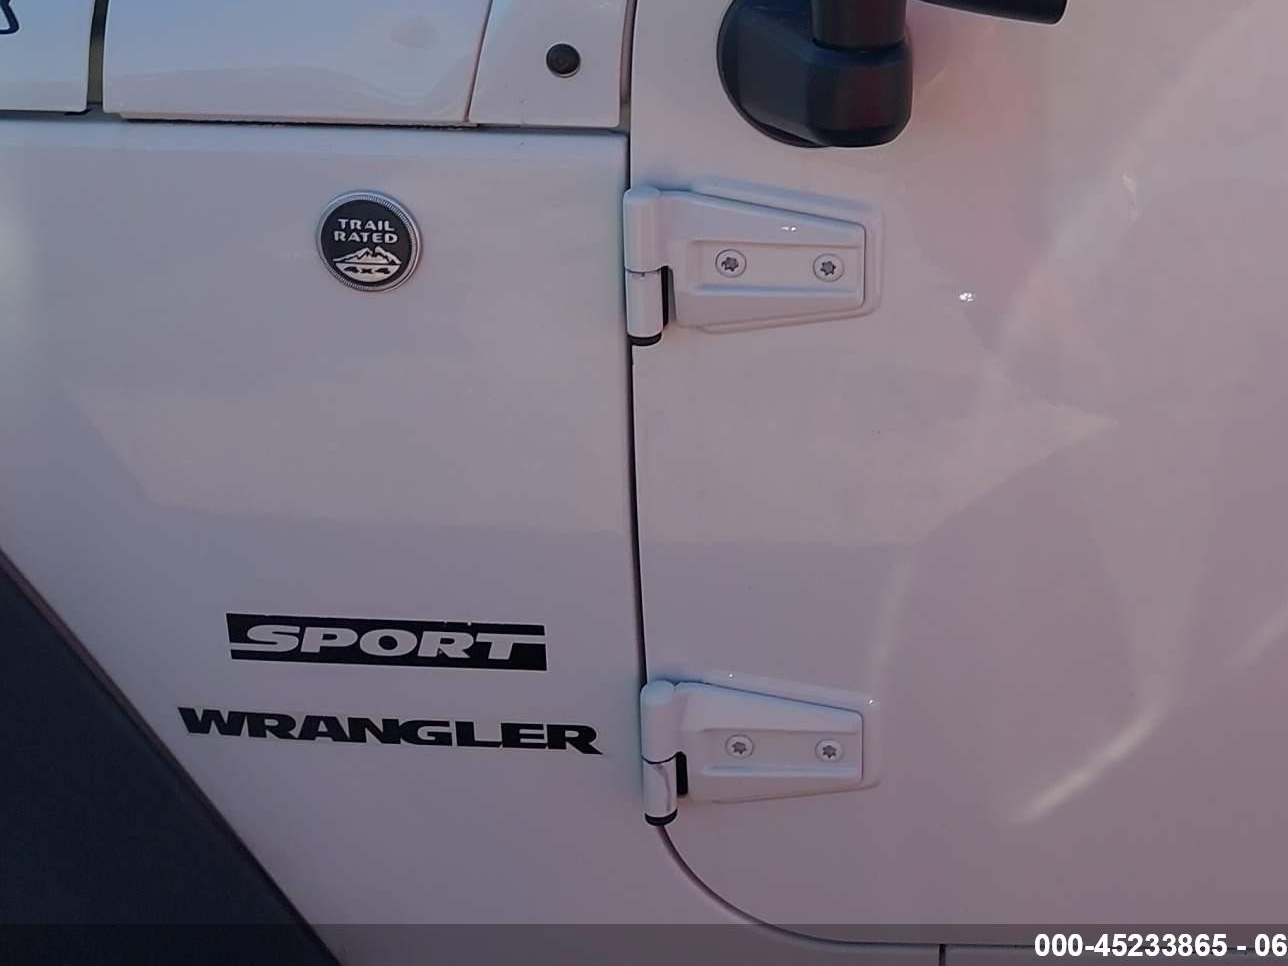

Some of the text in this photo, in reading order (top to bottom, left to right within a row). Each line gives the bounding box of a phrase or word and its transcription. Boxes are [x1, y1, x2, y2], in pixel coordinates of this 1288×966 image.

[333, 230, 398, 244] RATED
[337, 218, 395, 232] TRAIL
[231, 622, 546, 661] SPORT
[177, 706, 603, 755] WRANGLER
